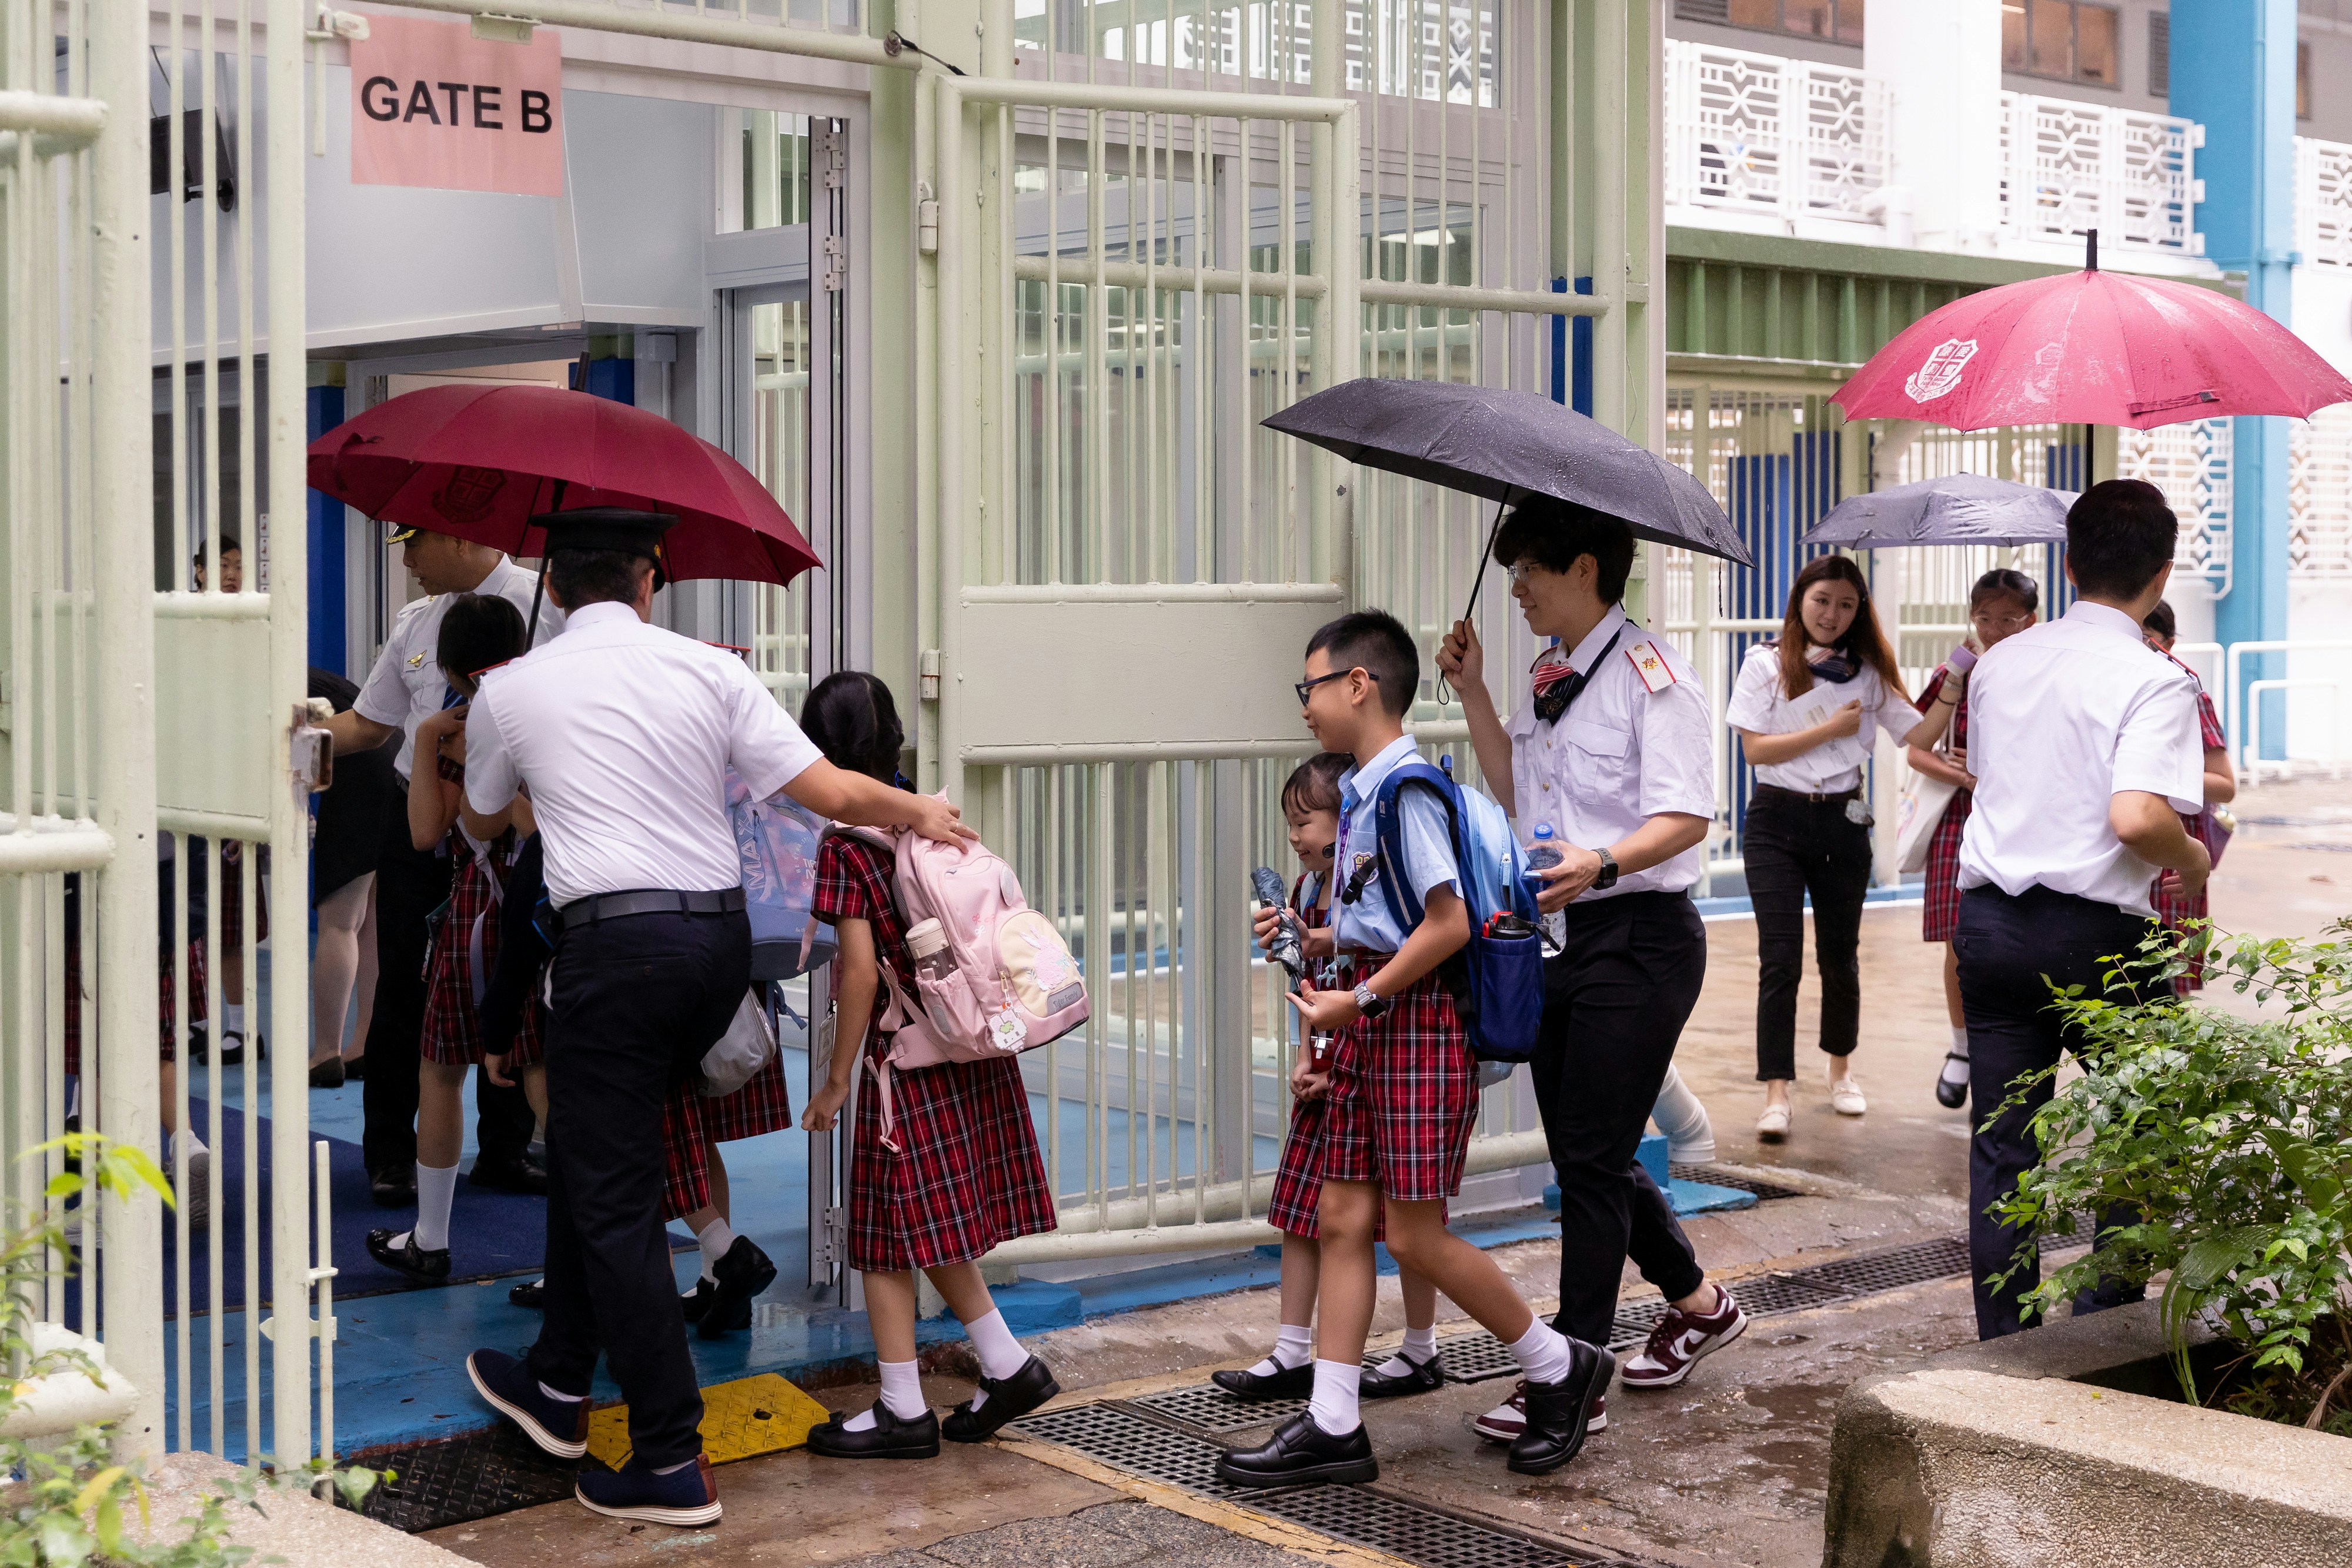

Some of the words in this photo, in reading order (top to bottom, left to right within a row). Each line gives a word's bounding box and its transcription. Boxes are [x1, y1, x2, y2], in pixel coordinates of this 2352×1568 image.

[360, 76, 503, 130] GATE
[520, 89, 553, 133] B
[1053, 998, 1064, 1008] Tiger
